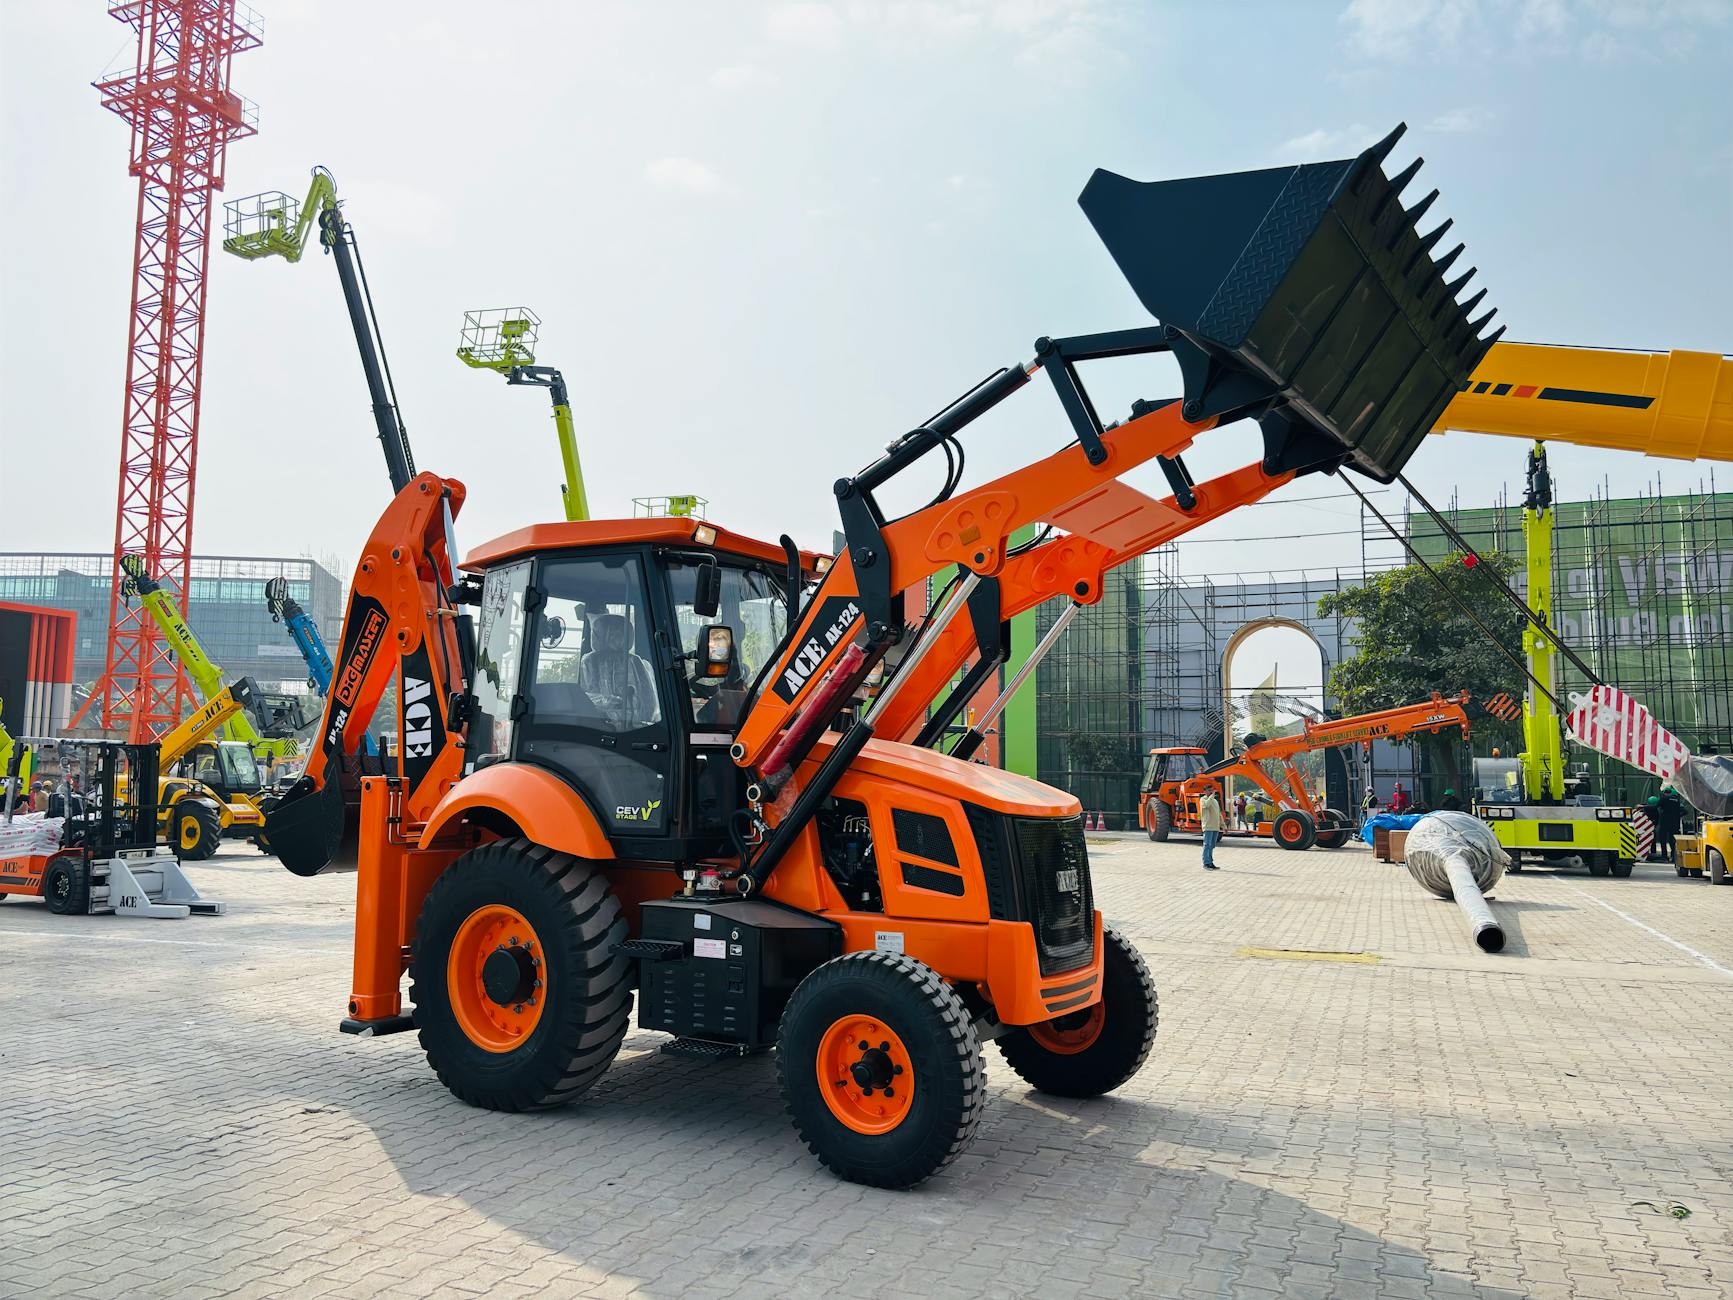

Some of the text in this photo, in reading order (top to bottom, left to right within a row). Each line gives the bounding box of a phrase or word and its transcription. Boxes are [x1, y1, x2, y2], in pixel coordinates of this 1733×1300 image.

[174, 623, 192, 644] ACE
[784, 637, 827, 695] ACE
[205, 698, 224, 721] ACE
[404, 676, 433, 759] ACE
[1369, 724, 1390, 736] ACE
[616, 806, 640, 815] CEV
[3, 862, 18, 873] ACE
[119, 896, 138, 908] ACE
